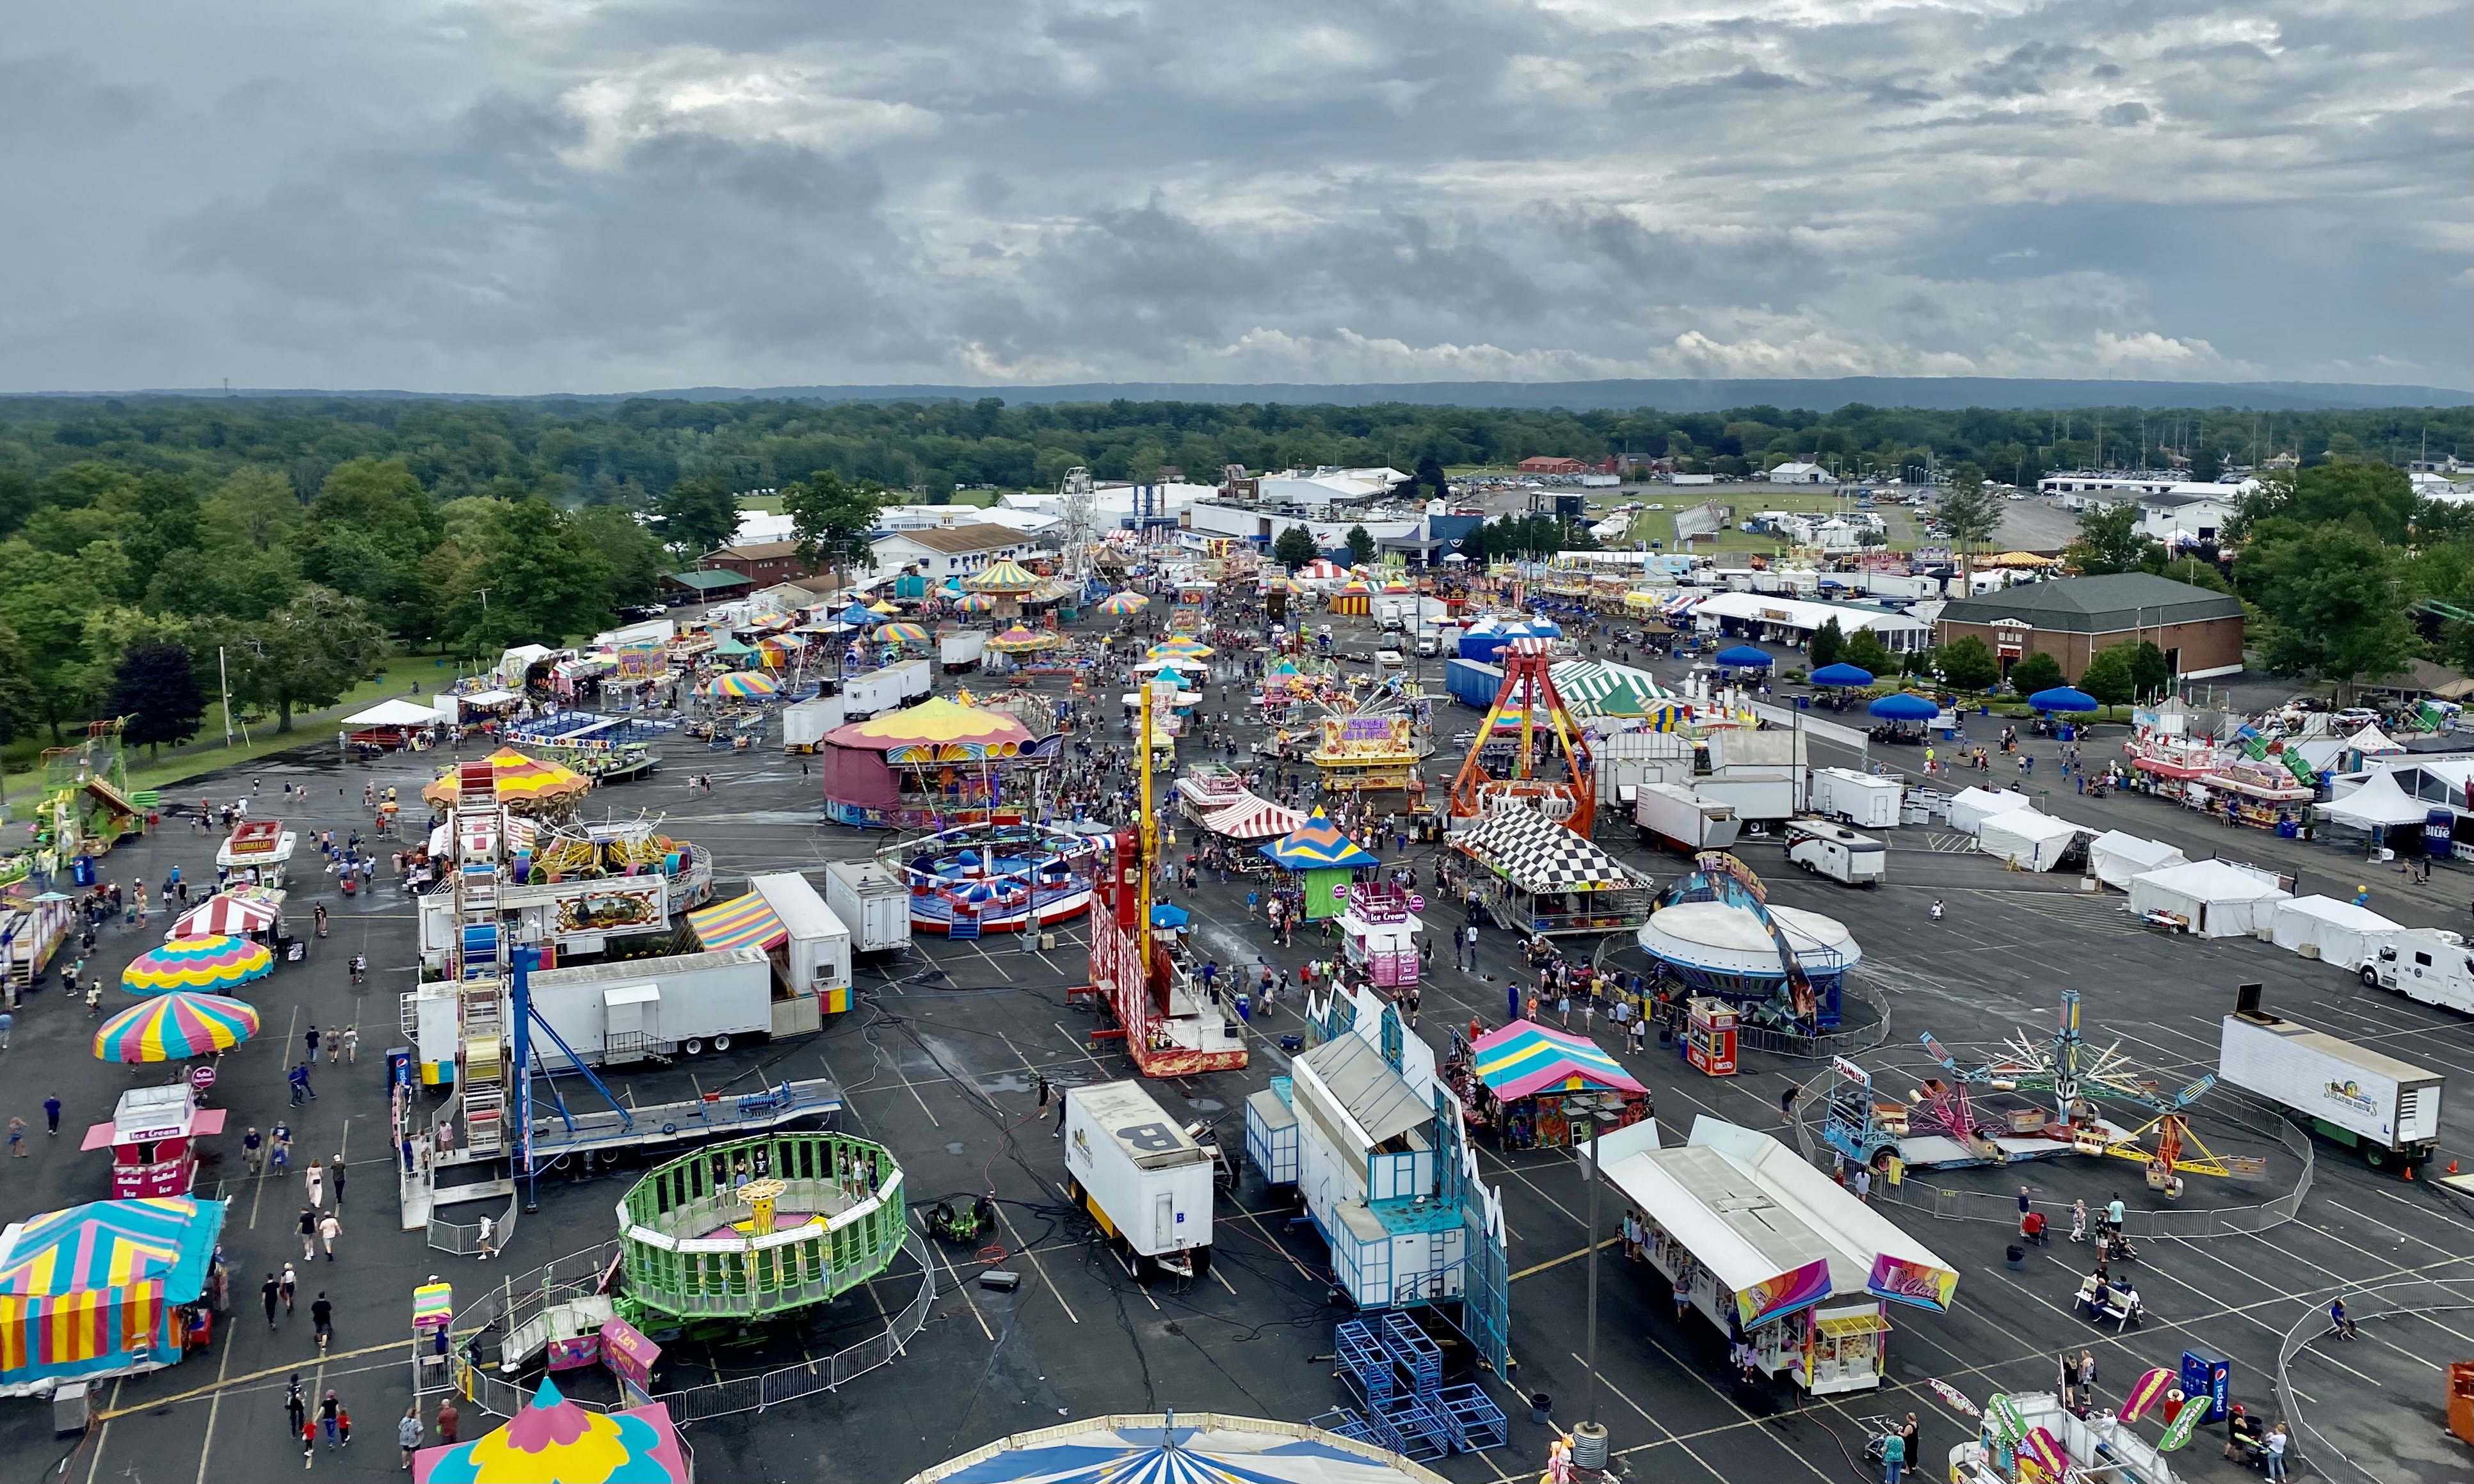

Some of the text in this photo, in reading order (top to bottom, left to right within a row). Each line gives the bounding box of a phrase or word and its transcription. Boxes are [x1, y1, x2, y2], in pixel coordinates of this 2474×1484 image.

[1347, 718, 1388, 729] CHICKEN
[2426, 825, 2450, 838] Blue
[1371, 913, 1381, 922] Ice
[398, 1069, 407, 1087] epsi
[1833, 1059, 1866, 1086] SCRAMBLER
[148, 1128, 179, 1138] Cream
[2383, 1124, 2390, 1135] L
[1116, 1122, 1184, 1151] B
[152, 1170, 177, 1183] Rolled
[124, 1189, 136, 1198] Ice
[159, 1185, 172, 1194] Ice
[1177, 1213, 1185, 1223] B
[1900, 1277, 1941, 1298] Claw
[617, 1327, 638, 1351] Zero
[609, 1341, 636, 1373] Gravity
[1930, 1380, 1980, 1417] BANANA CREAM
[2037, 1465, 2059, 1484] Caf
